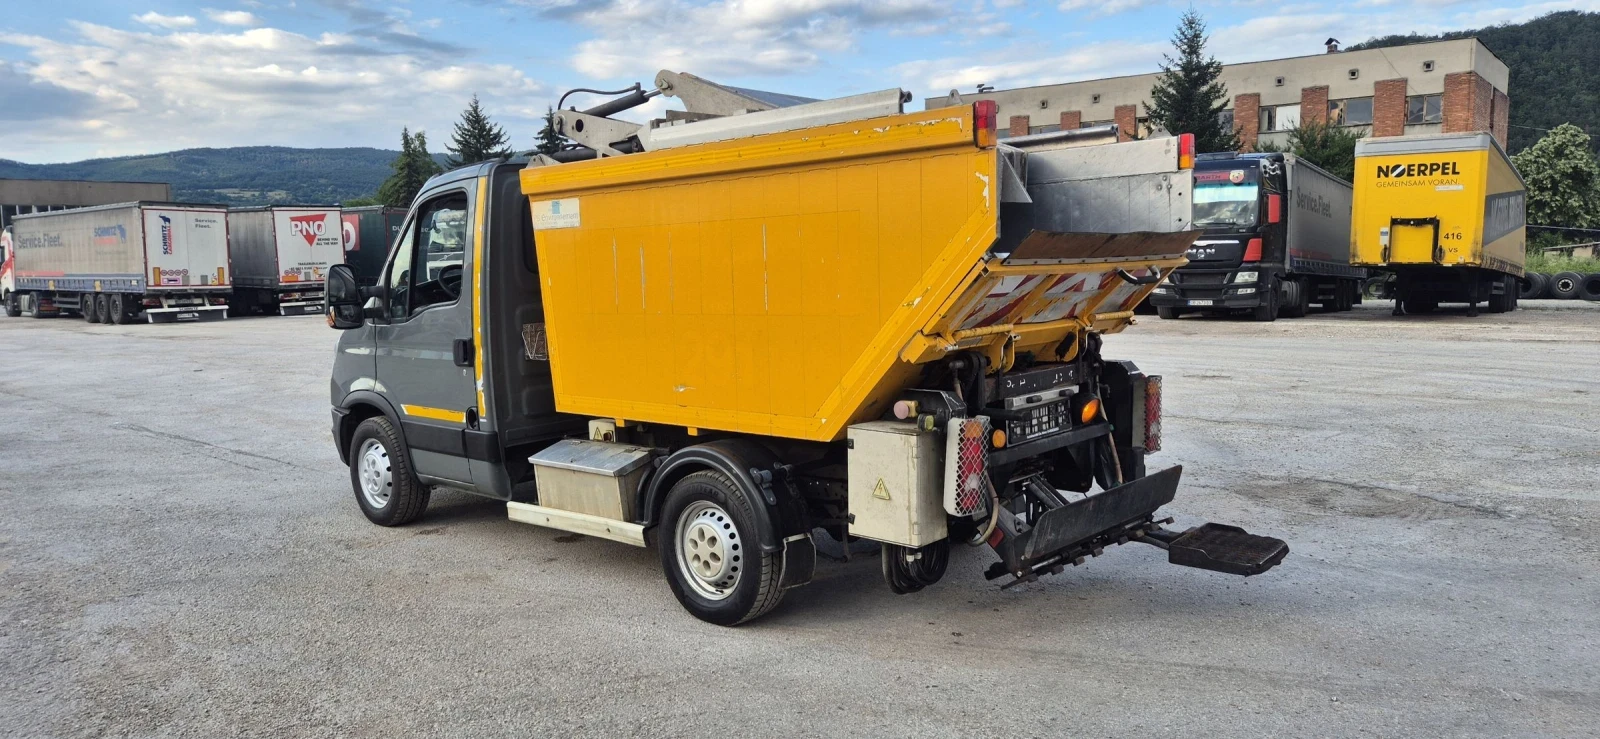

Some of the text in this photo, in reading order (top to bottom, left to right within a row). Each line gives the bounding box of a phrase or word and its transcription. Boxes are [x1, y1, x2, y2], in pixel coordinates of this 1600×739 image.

[1377, 162, 1460, 178] NOERPEL
[290, 220, 326, 236] PNO
[1443, 232, 1462, 240] 416
